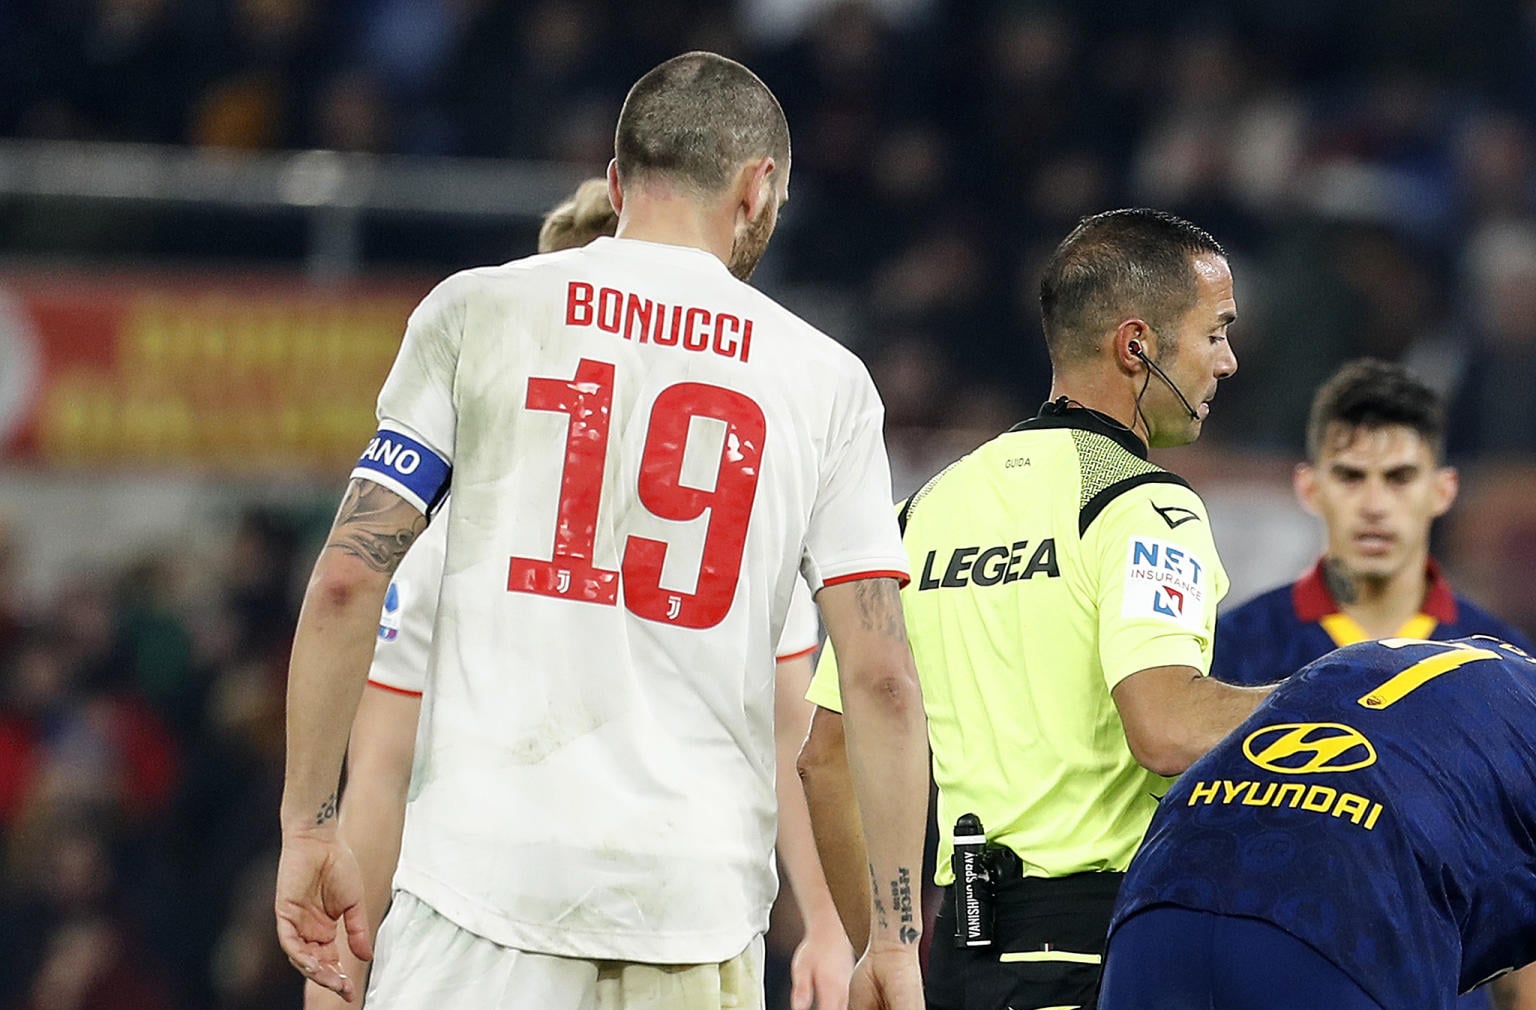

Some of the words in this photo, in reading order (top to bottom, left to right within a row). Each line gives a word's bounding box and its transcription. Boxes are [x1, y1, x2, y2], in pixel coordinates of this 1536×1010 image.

[565, 281, 753, 363] BONUCCI
[360, 437, 421, 475] ANO
[1005, 457, 1032, 469] GUIDA
[507, 358, 767, 630] 19
[918, 538, 1061, 591] LEGEA
[1130, 569, 1202, 602] INSURANCE
[1133, 541, 1202, 585] NET
[1188, 780, 1384, 830] HYUNDAI
